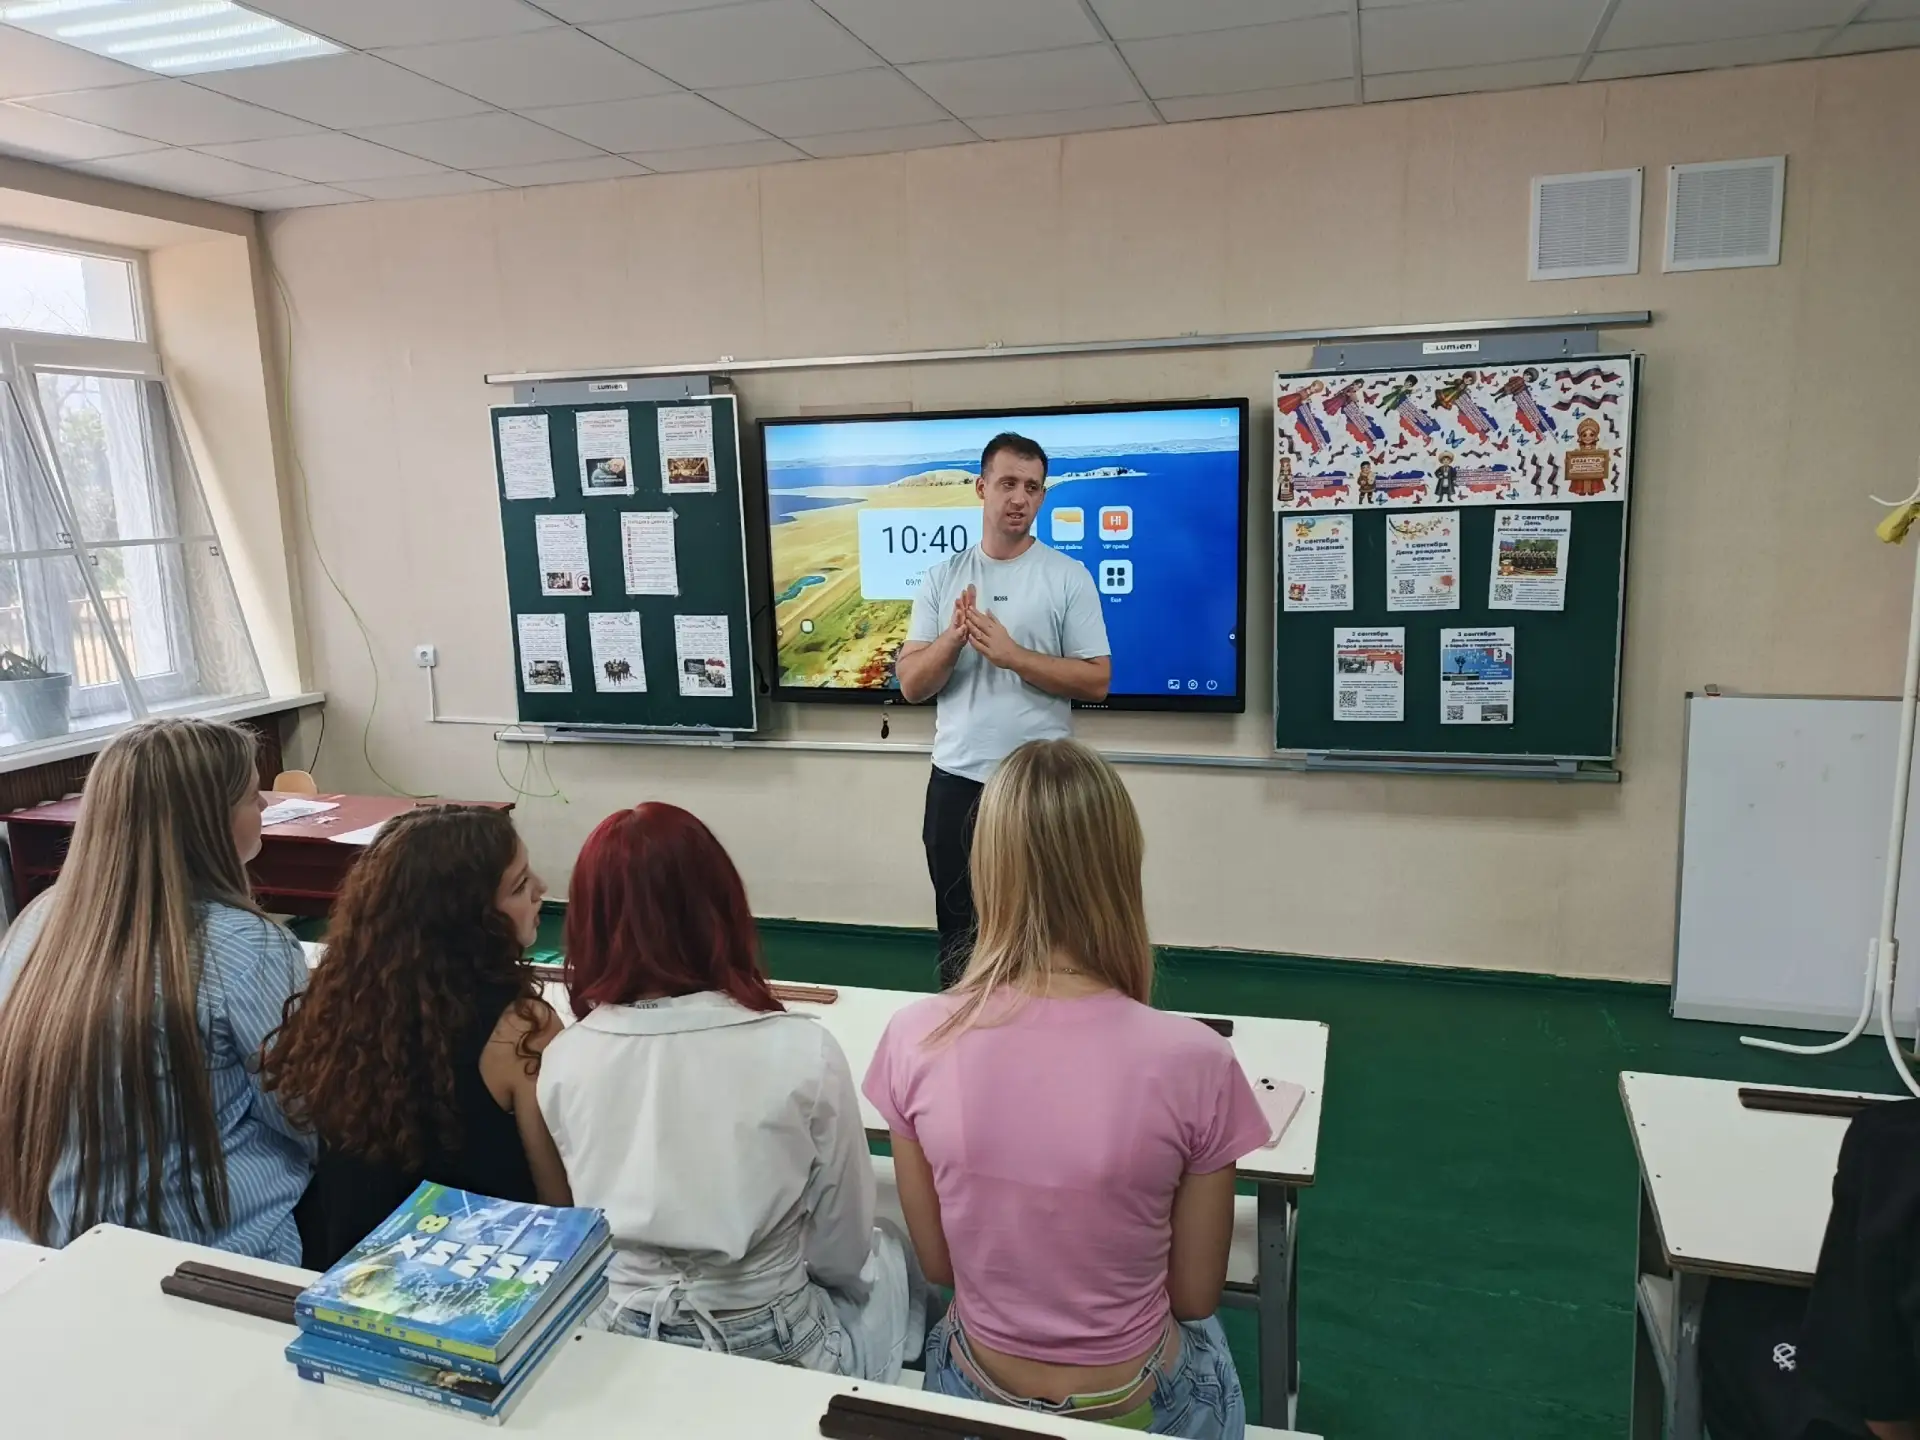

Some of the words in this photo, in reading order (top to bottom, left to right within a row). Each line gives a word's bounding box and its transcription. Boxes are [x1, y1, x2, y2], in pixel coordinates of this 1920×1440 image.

[1110, 515, 1121, 526] Hi
[882, 524, 968, 554] 10:40
[1304, 537, 1339, 545] сентября
[1411, 541, 1448, 549] сентября
[1496, 649, 1503, 659] 3
[1383, 661, 1390, 671] 3
[416, 1213, 451, 1234] 8
[391, 1233, 562, 1286] ХИМИЯ
